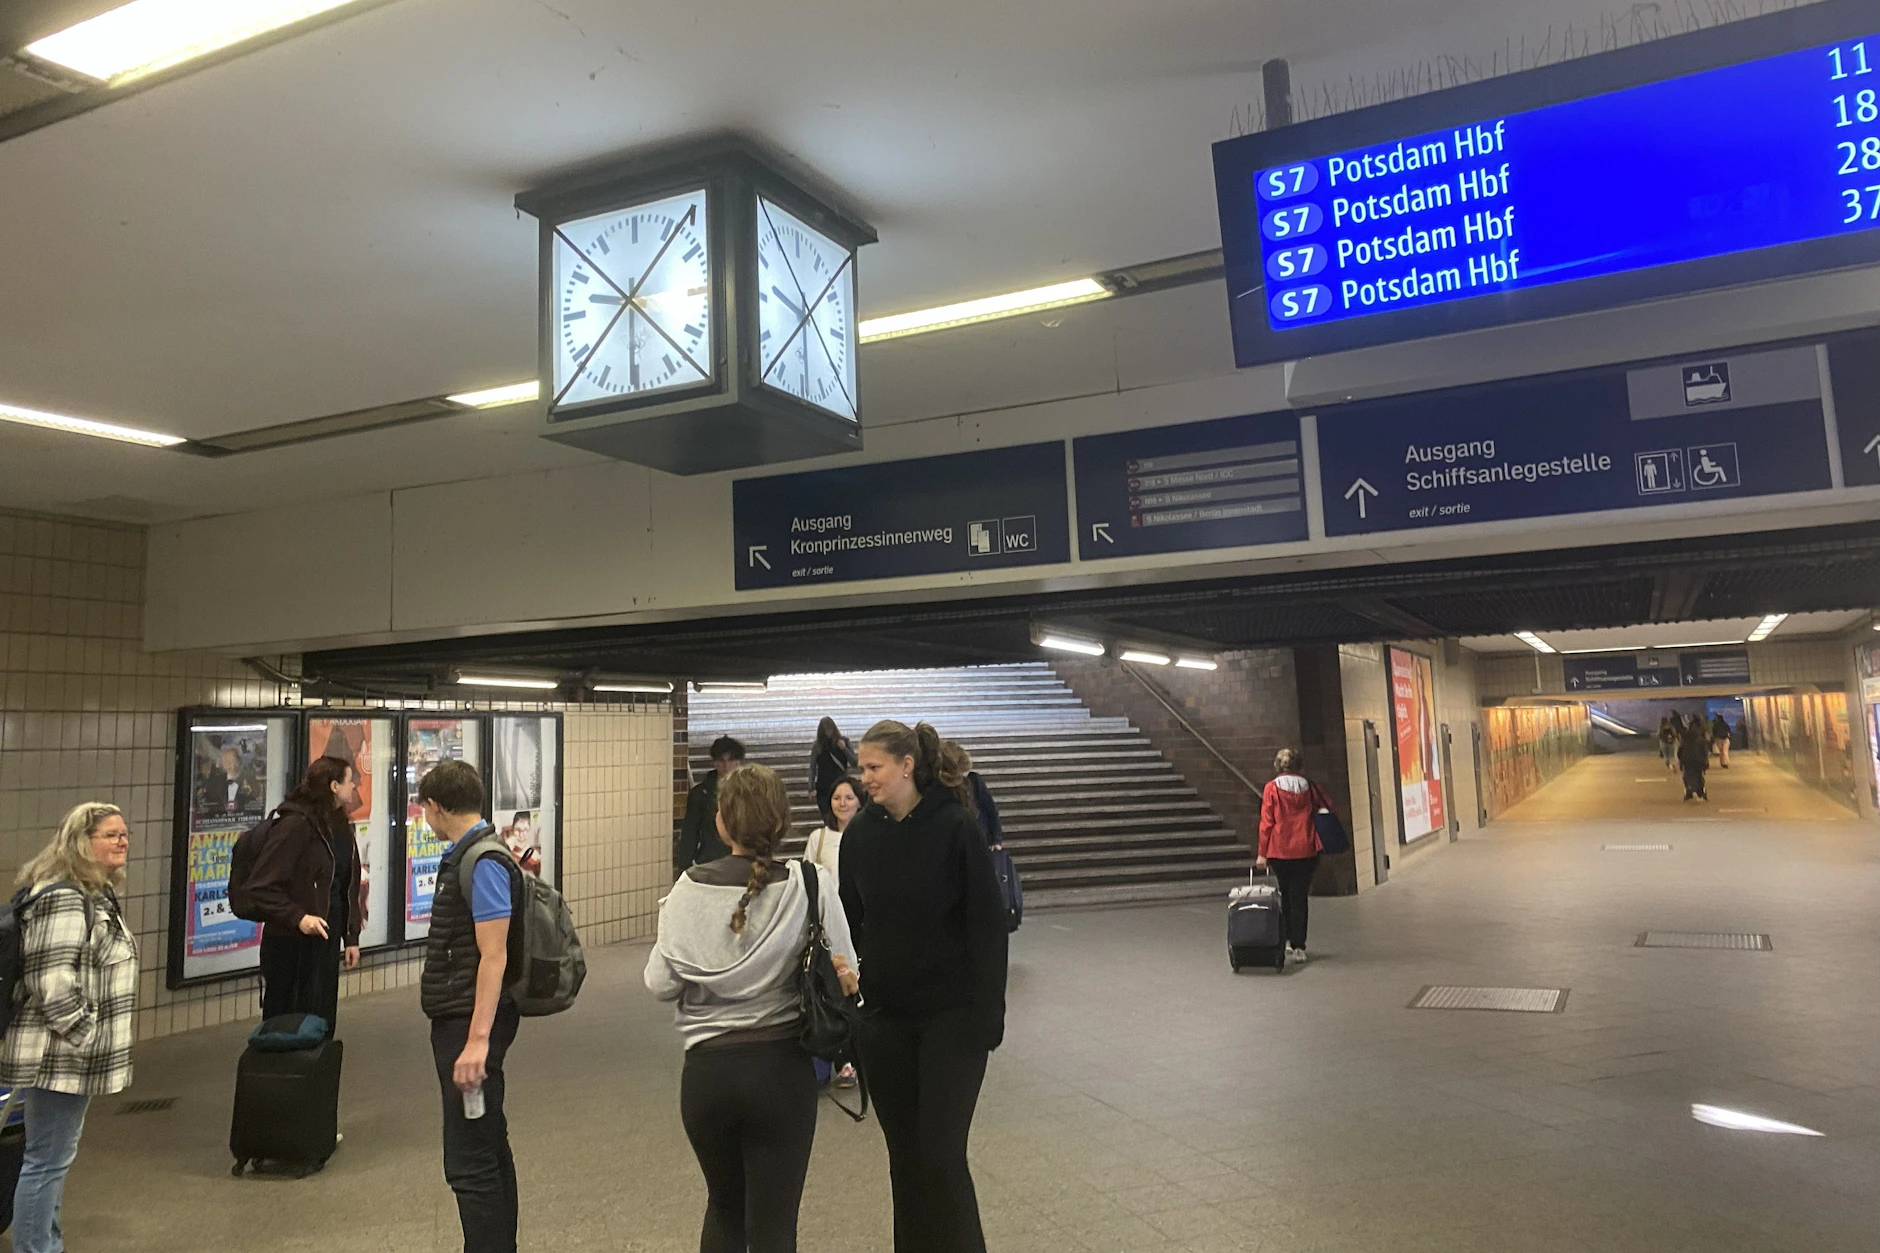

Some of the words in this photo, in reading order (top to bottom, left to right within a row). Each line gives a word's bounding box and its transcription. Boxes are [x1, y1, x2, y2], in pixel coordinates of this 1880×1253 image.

[1268, 165, 1305, 197] S7
[1328, 142, 1447, 187] Potsdam
[1454, 120, 1505, 160] Hbf
[1827, 41, 1873, 81] 11
[1272, 206, 1310, 237] S7
[1333, 184, 1452, 228] Potsdam
[1458, 163, 1510, 202] Hbf
[1832, 88, 1879, 128] 18
[1277, 247, 1315, 278] S7
[1337, 225, 1457, 268] Potsdam
[1463, 206, 1515, 245] Hbf
[1837, 136, 1880, 175] 28
[1281, 287, 1319, 318] S7
[1341, 267, 1462, 309] Potsdam
[1468, 249, 1520, 287] Hbf
[1841, 184, 1880, 224] 37
[1405, 439, 1496, 464] Ausgang
[1406, 452, 1612, 491] Schiffsanlegestelle
[790, 513, 852, 533] Ausgang
[1409, 505, 1429, 519] exit
[1439, 502, 1471, 516] sortie
[790, 526, 953, 555] Kronprinzessinnenweg
[1005, 532, 1029, 548] WC
[792, 566, 807, 578] exit
[812, 565, 834, 576] sortie
[411, 864, 439, 876] KARLS
[195, 888, 229, 902] KARLS
[217, 903, 225, 913] &
